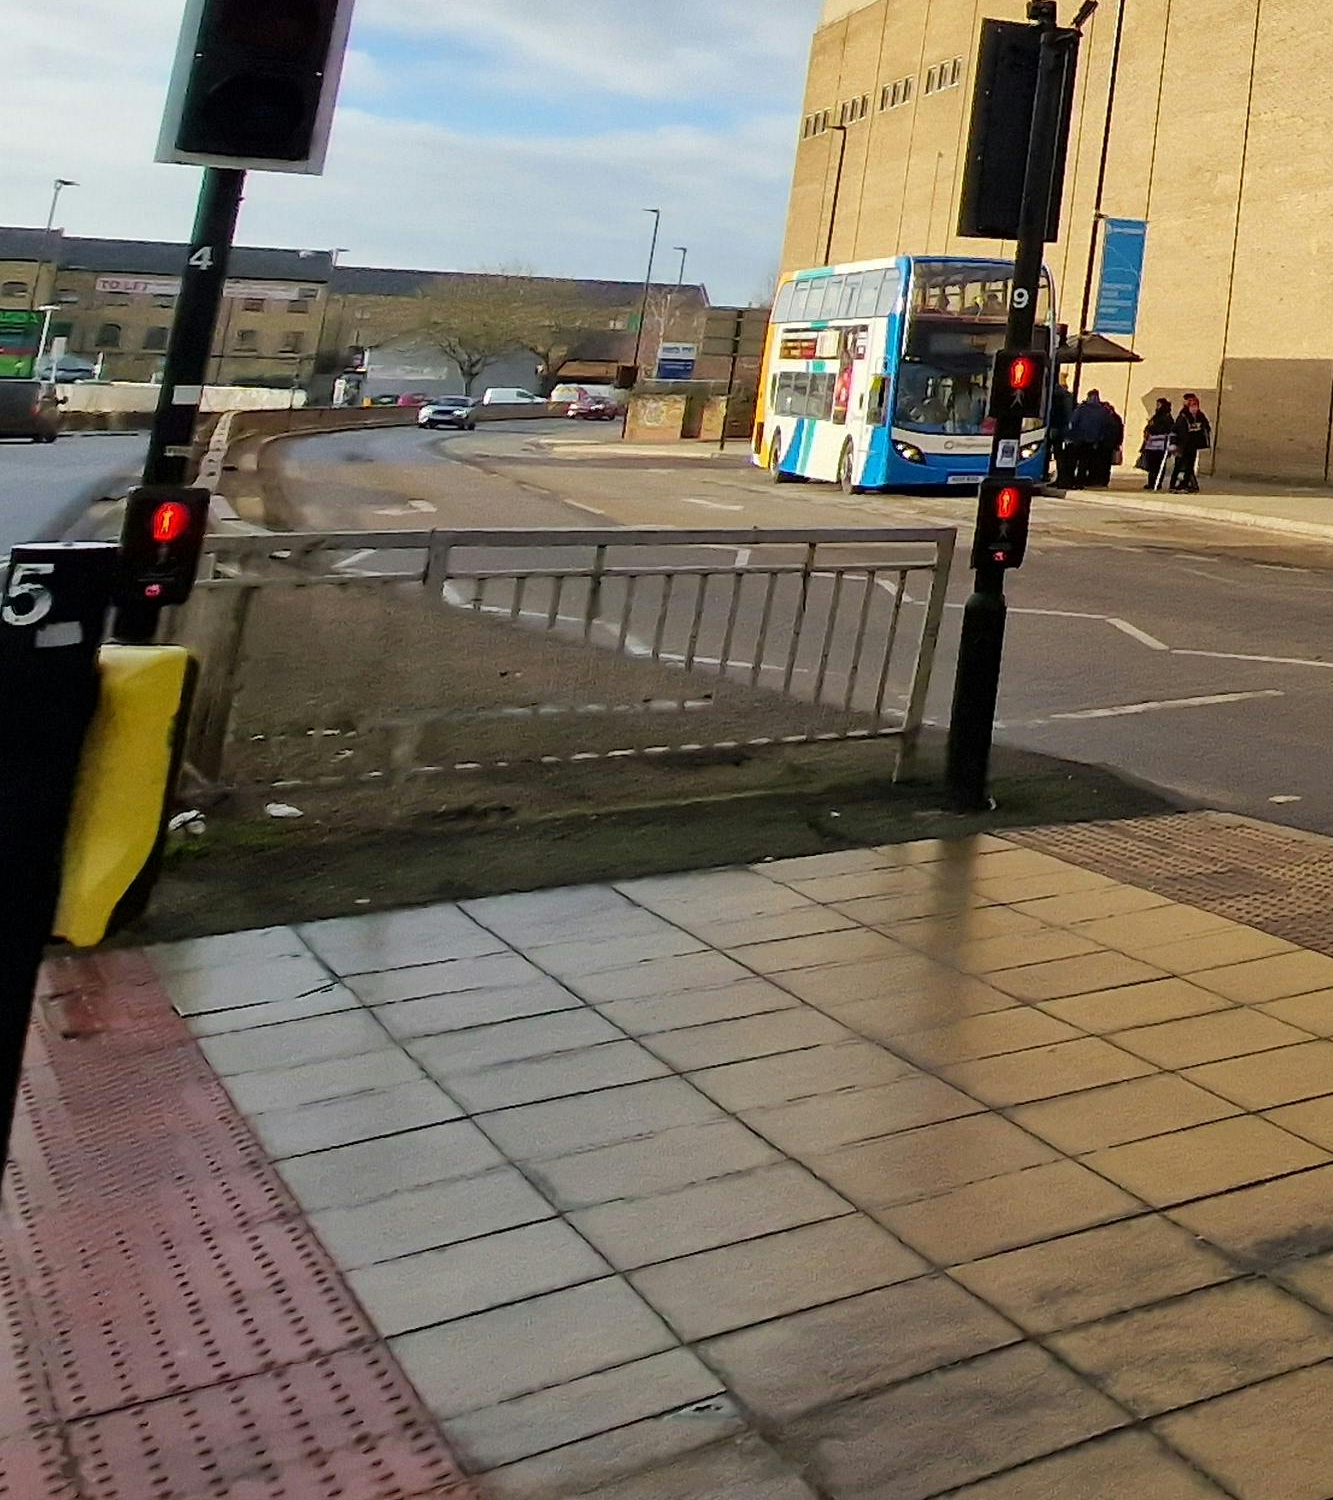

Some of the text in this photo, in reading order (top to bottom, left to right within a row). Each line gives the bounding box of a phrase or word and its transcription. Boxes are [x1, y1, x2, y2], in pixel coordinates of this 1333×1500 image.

[188, 246, 214, 271] 4
[100, 279, 120, 292] TO
[1012, 287, 1029, 309] 9
[2, 563, 55, 626] 5
